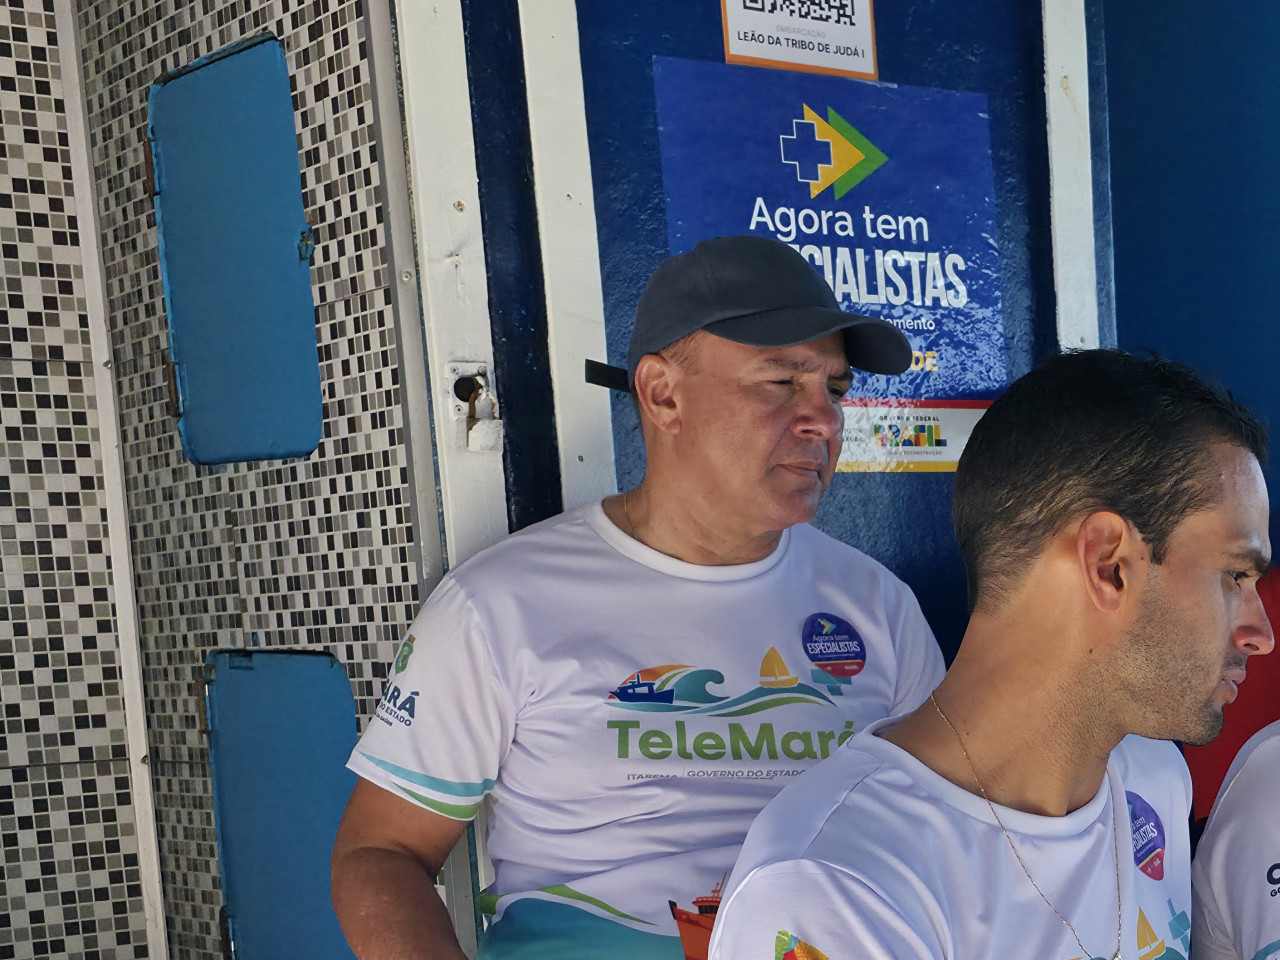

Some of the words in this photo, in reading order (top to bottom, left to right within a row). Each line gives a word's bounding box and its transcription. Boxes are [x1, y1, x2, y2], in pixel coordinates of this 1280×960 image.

[737, 30, 765, 44] LEÃO
[767, 35, 782, 47] DA
[784, 37, 815, 51] TRIBO
[817, 42, 831, 54] DE
[833, 45, 860, 58] JUDÁ
[749, 197, 854, 242] Agora
[862, 205, 929, 242] tem
[873, 424, 947, 447] BRASIL
[806, 640, 861, 655] ESPECIALISTAS
[812, 634, 834, 643] Agora
[385, 706, 412, 726] ESTADO
[687, 770, 744, 778] GOVERNO
[746, 770, 764, 778] DO
